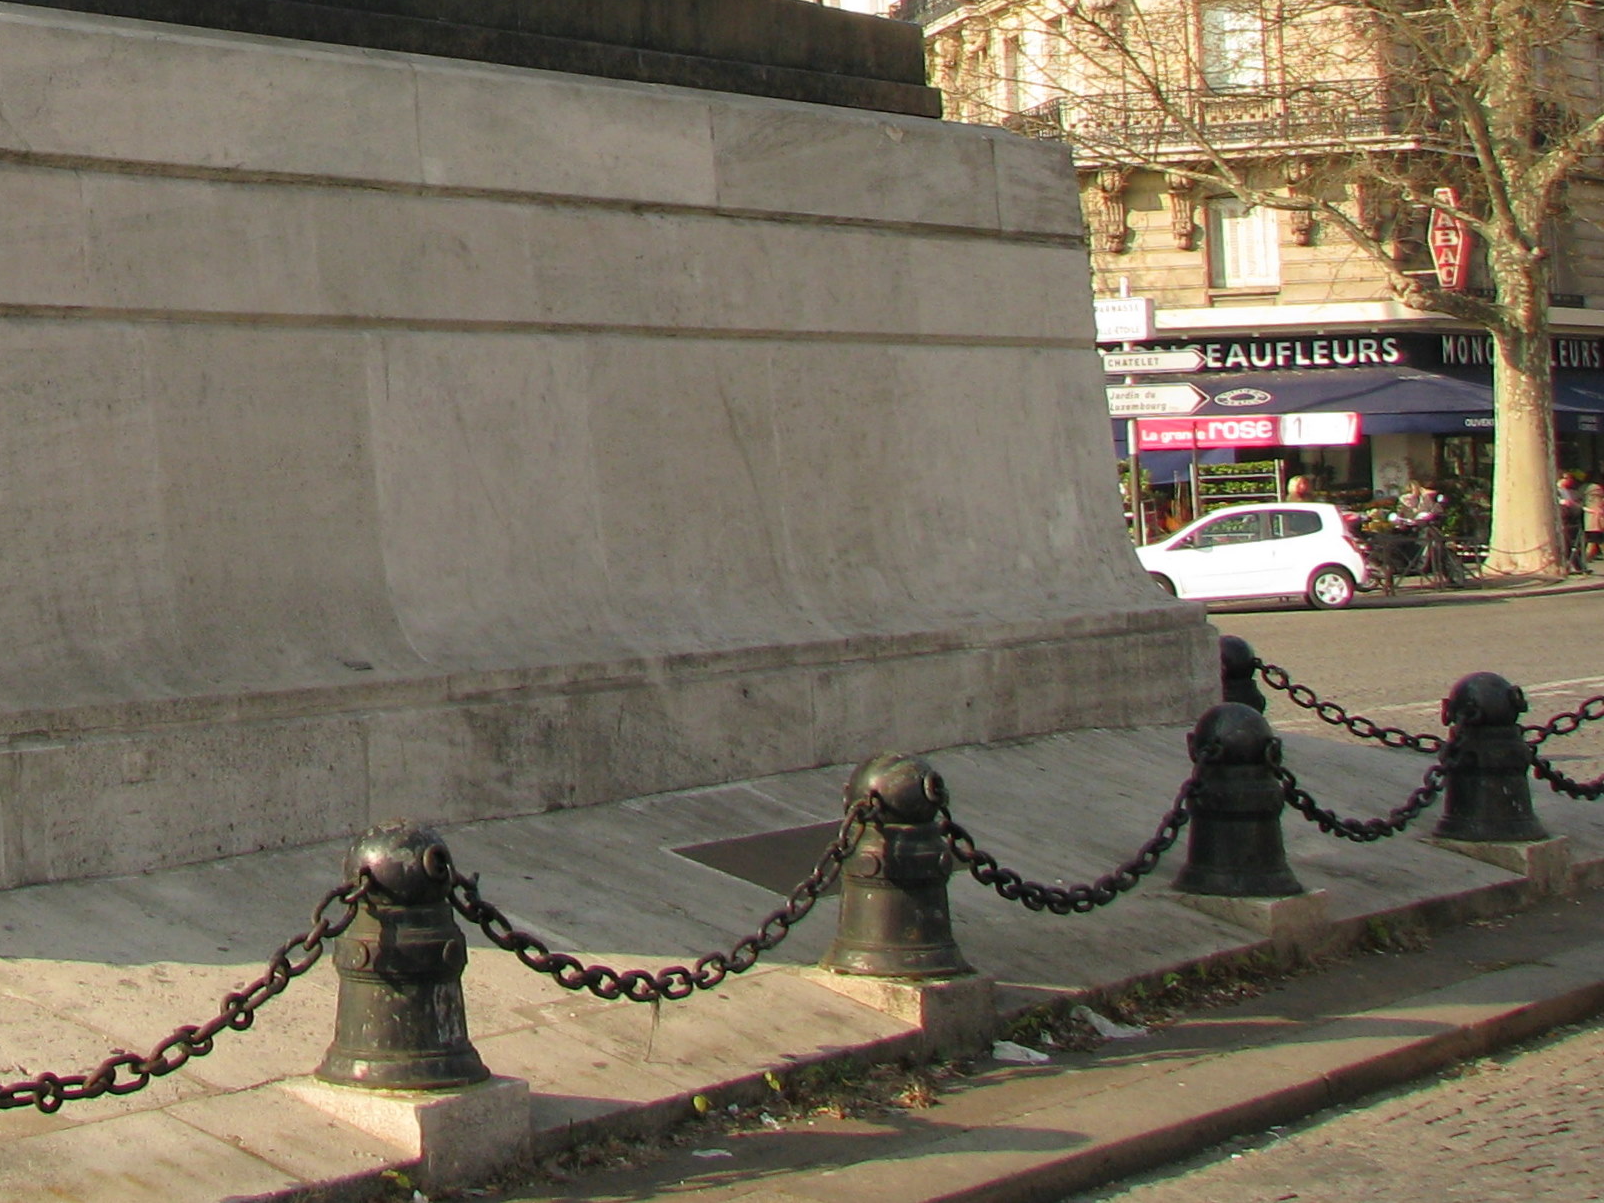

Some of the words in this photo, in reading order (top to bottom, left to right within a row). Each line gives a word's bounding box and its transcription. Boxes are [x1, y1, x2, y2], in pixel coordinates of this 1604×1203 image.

[1434, 191, 1459, 282] TABAC
[1107, 357, 1160, 367] CHATELET
[1141, 430, 1157, 440] La
[1208, 420, 1273, 440] rose
